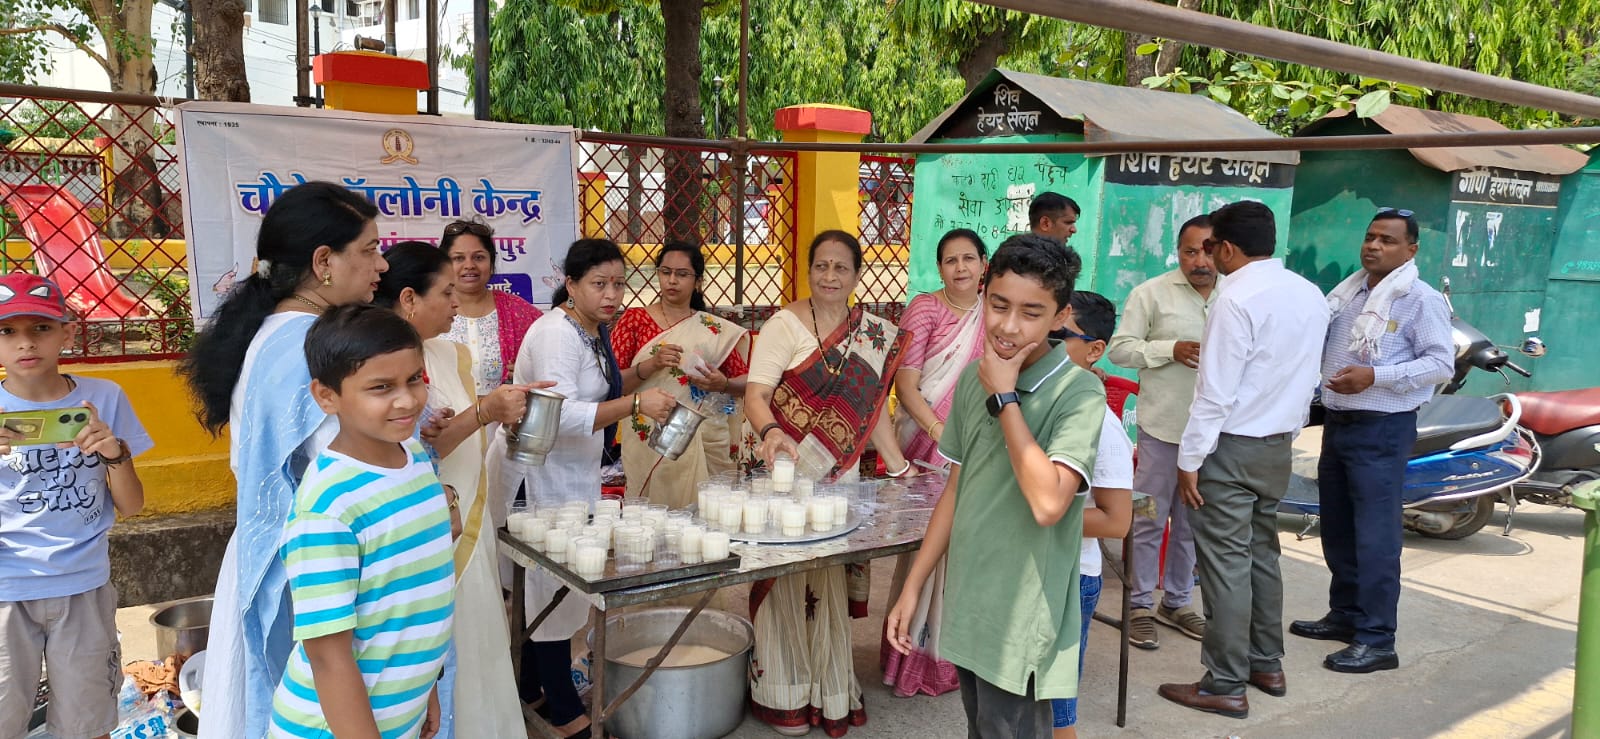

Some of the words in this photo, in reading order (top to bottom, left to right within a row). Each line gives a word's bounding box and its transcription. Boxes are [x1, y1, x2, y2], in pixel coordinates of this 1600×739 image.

[993, 83, 1022, 106] शिव
[976, 106, 1005, 133] हेयर
[1006, 105, 1042, 132] सेलून
[472, 178, 542, 223] केन्द्र
[40, 469, 77, 490] TO
[17, 486, 96, 513] STAY
